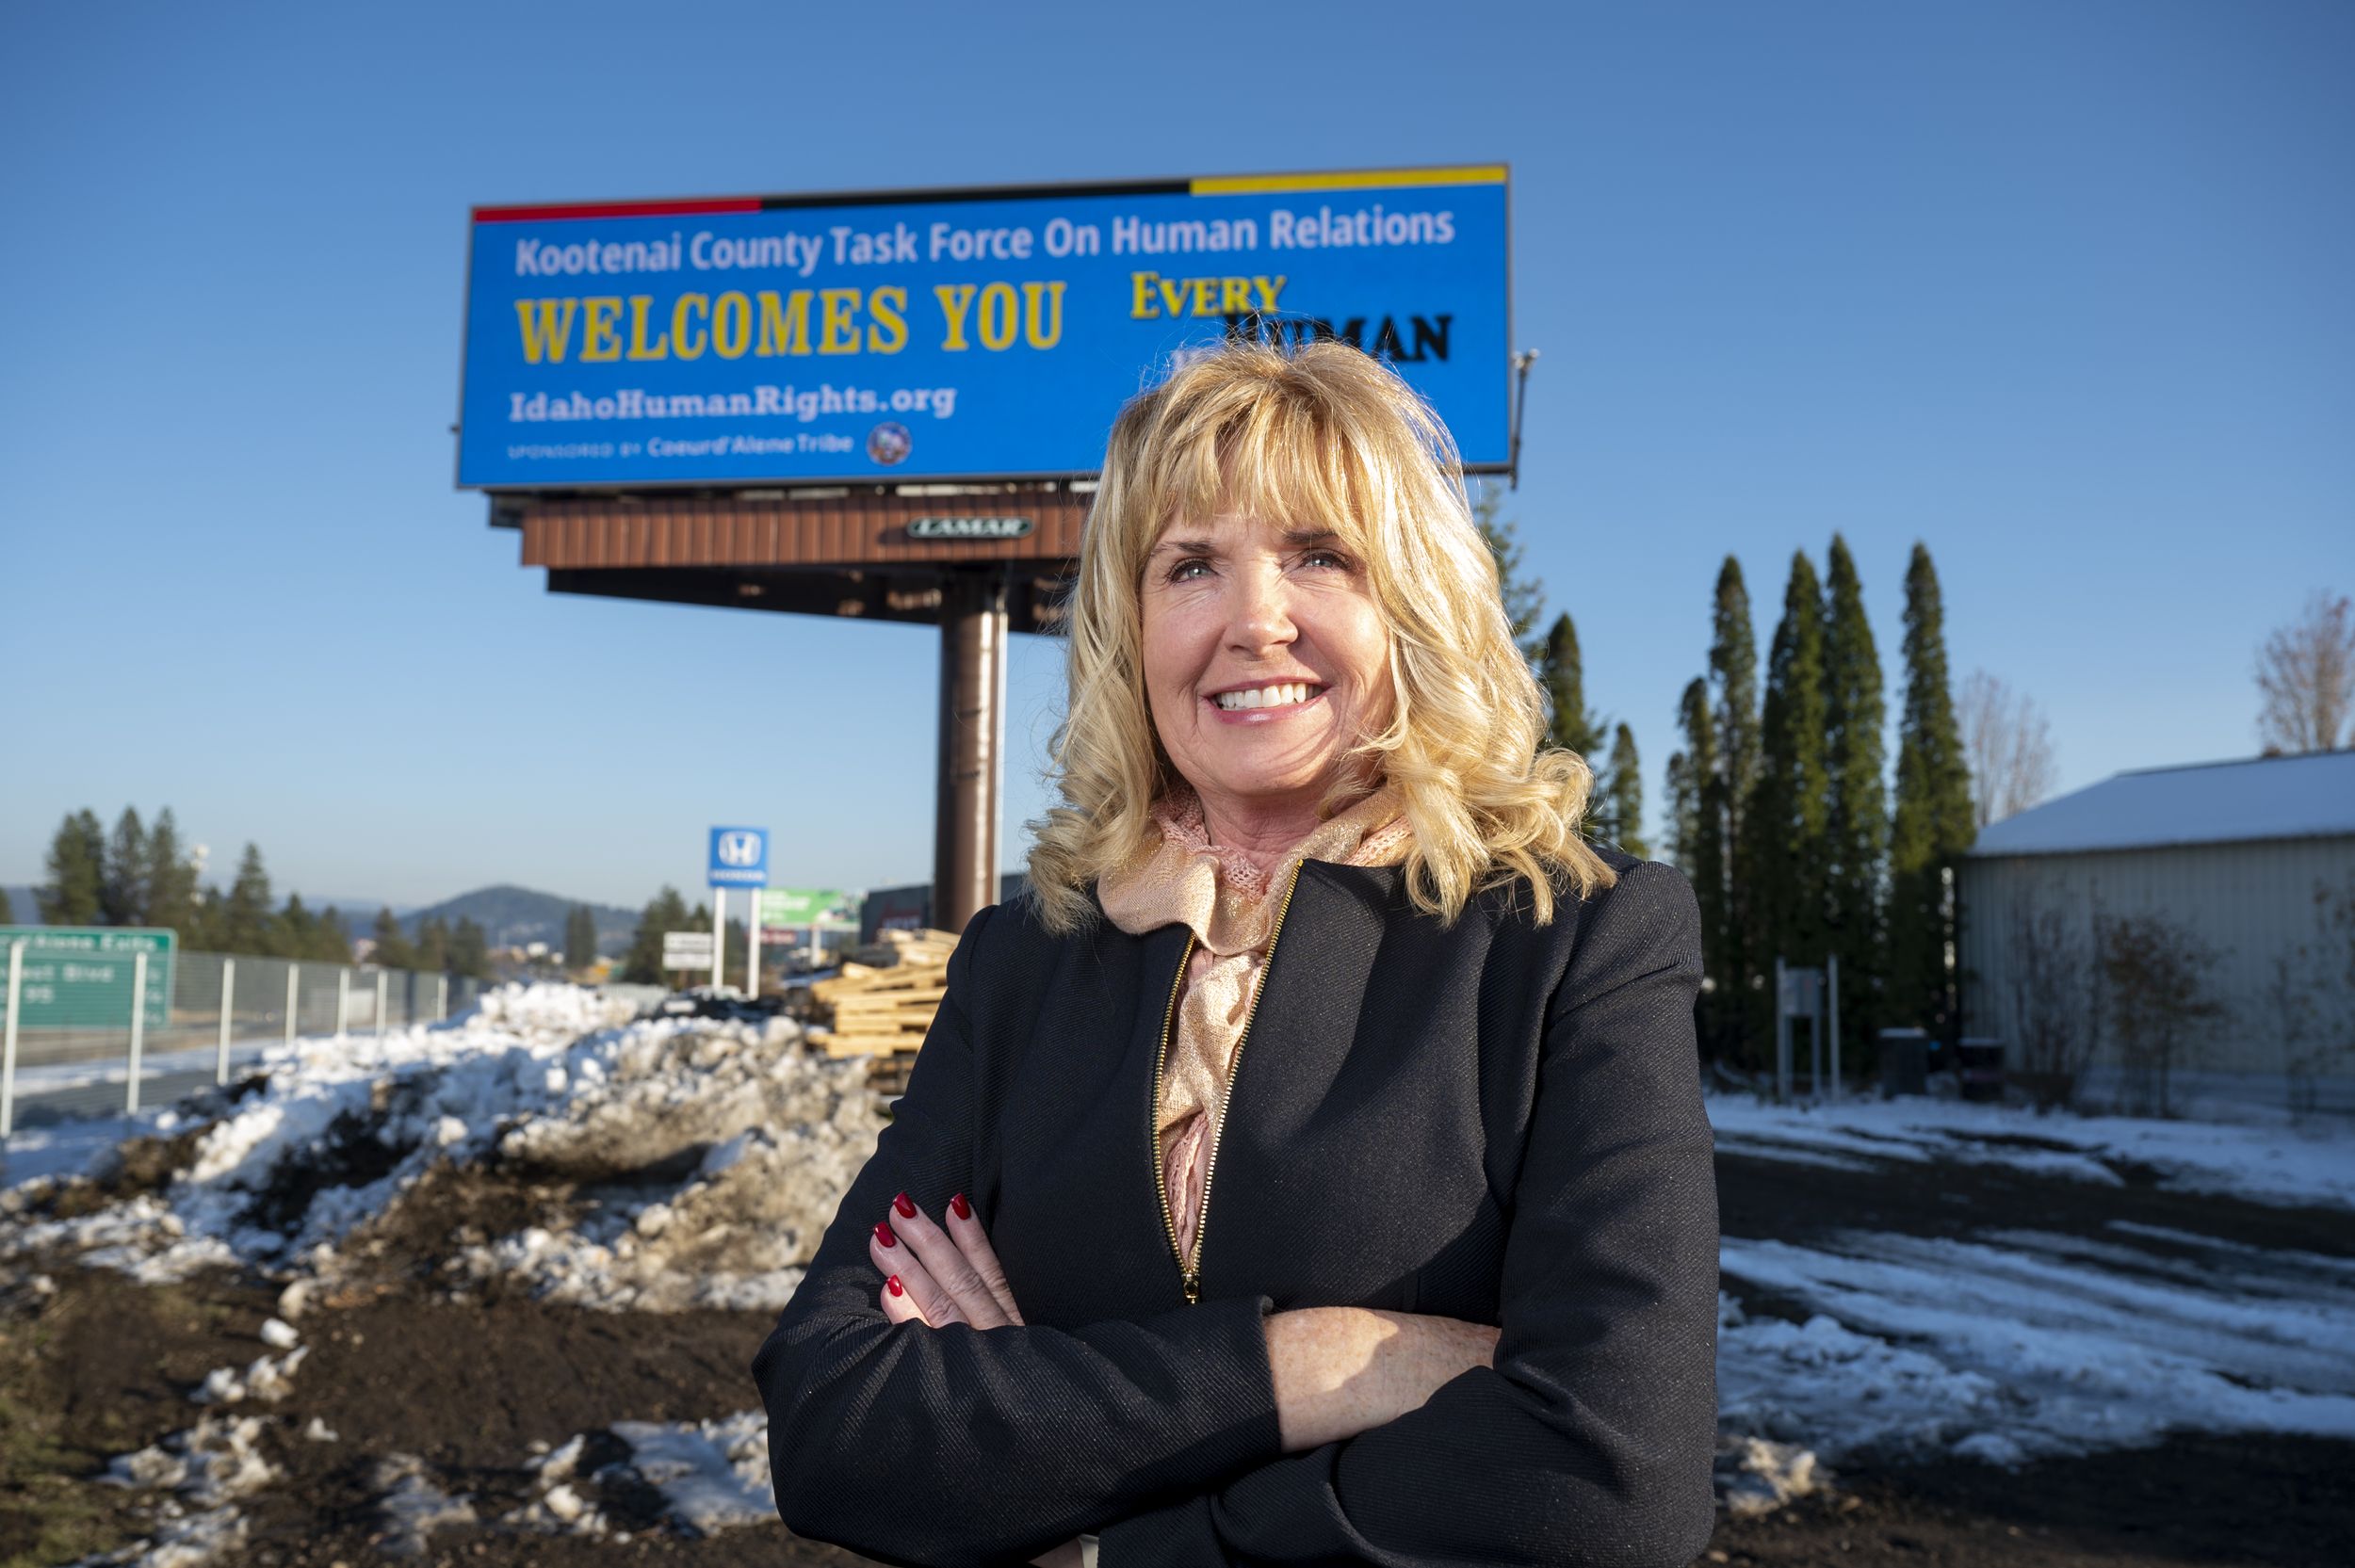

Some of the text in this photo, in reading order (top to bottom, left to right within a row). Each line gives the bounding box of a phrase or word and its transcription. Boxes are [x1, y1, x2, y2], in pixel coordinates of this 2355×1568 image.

[514, 205, 1455, 277] Kootenai County Task Force On Human Relations
[1129, 270, 1287, 320] EVERY
[513, 280, 1067, 364] WELCOMES YOU
[509, 384, 958, 422] IdahoHumanRights.org
[796, 432, 855, 454] Tribe
